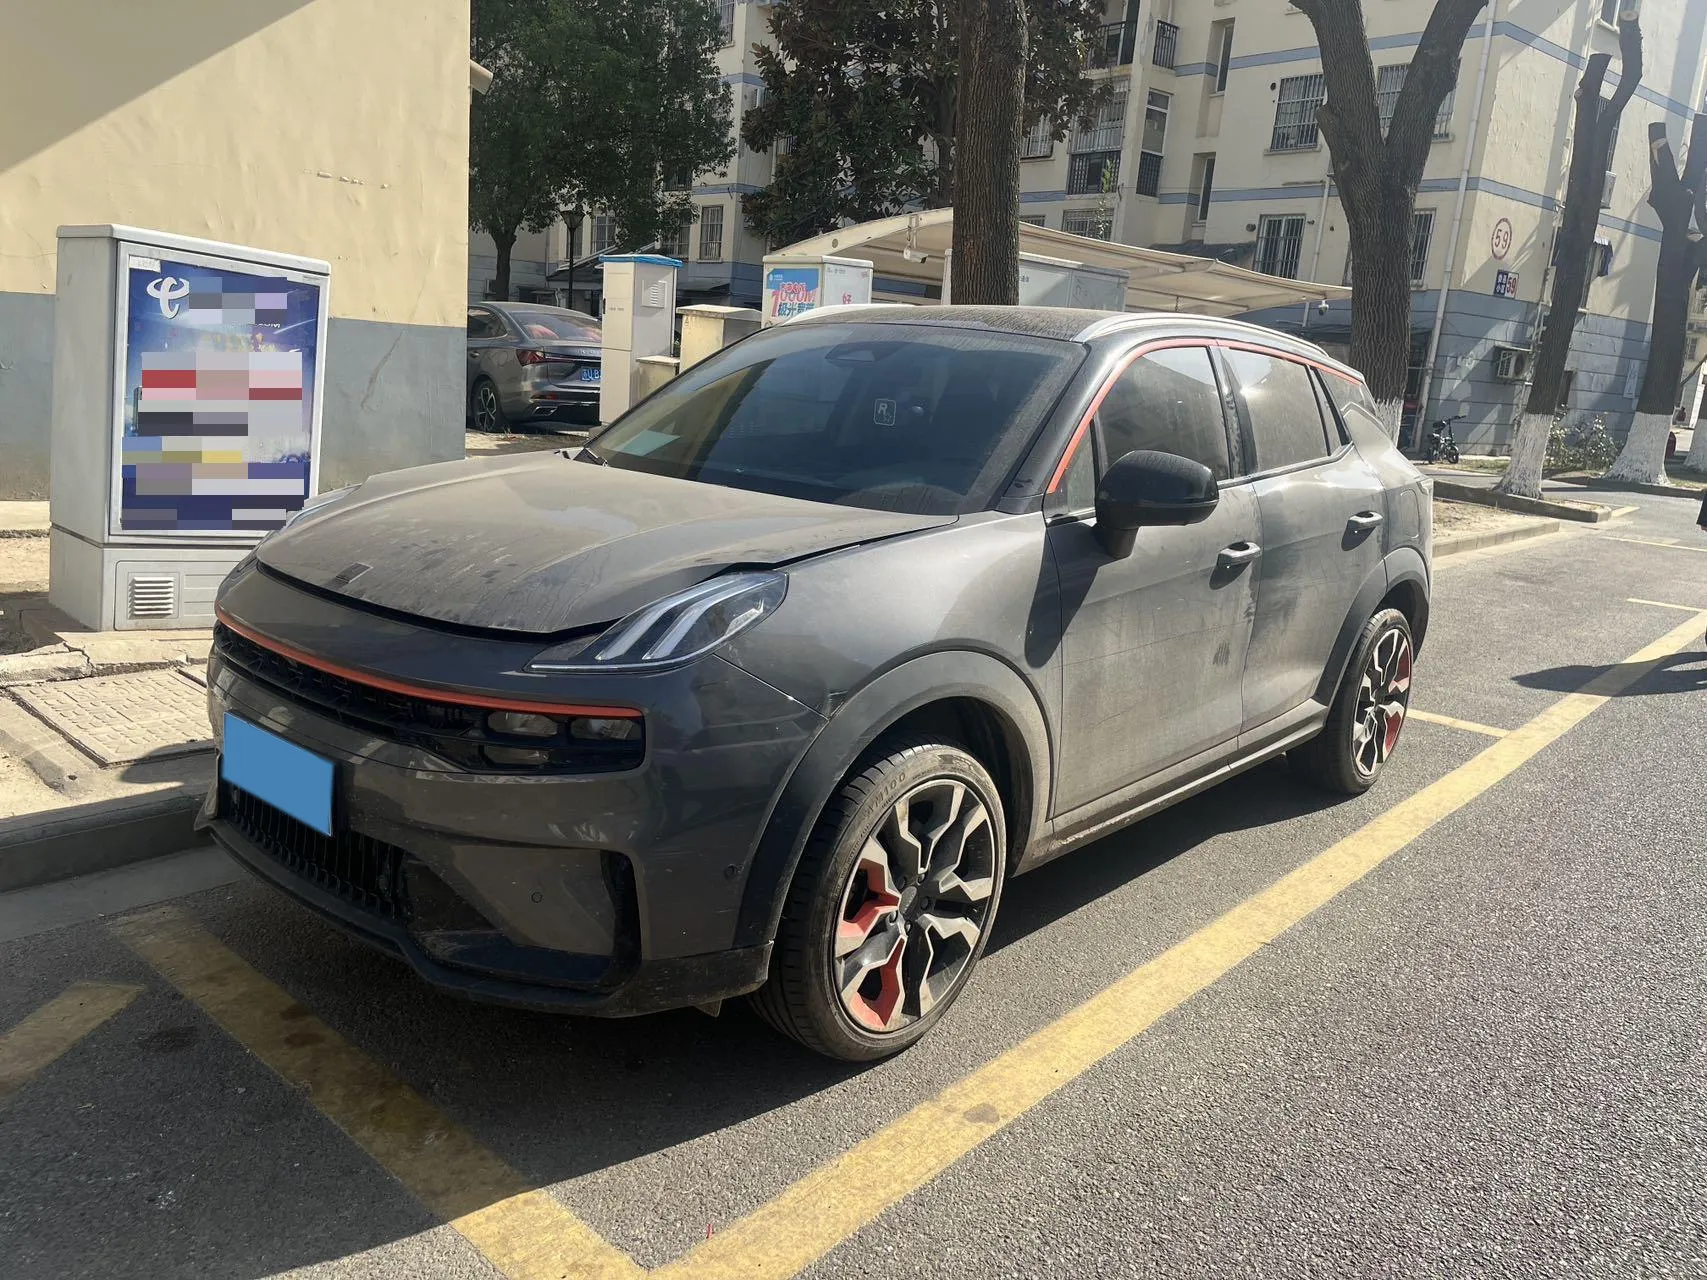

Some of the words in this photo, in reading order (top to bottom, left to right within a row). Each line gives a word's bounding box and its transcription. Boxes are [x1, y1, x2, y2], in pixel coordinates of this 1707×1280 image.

[1495, 229, 1508, 249] 59
[1506, 277, 1517, 294] 59
[878, 403, 888, 415] R
